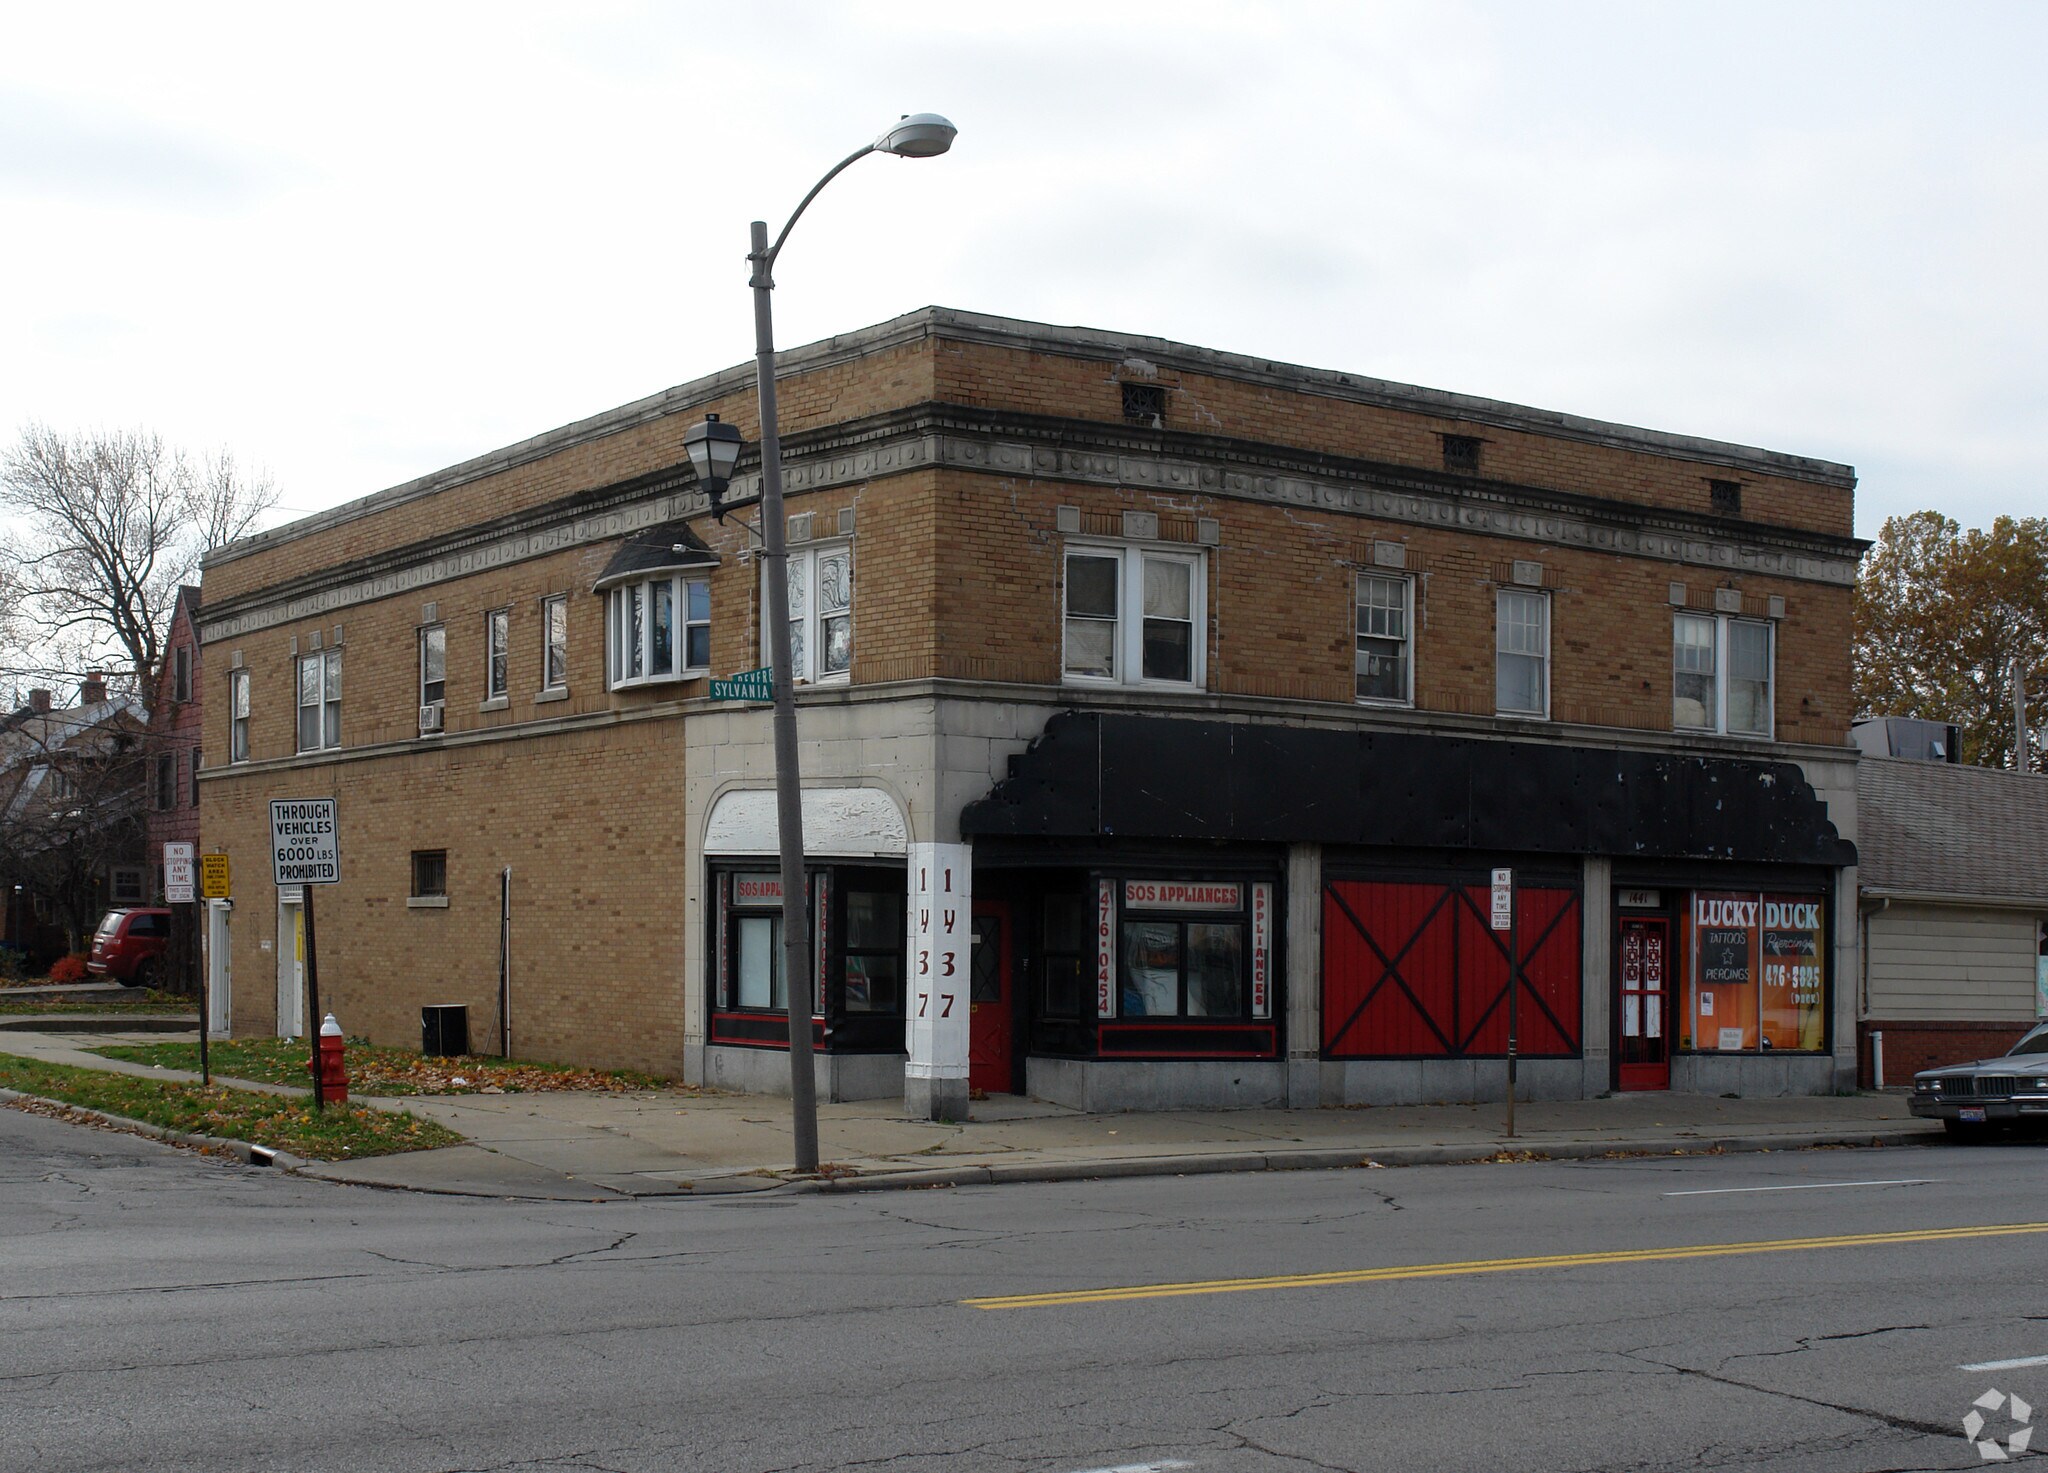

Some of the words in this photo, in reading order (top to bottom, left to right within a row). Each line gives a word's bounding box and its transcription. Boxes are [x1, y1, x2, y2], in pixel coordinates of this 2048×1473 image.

[715, 682, 769, 698] SYLVANIA
[275, 804, 330, 820] THROUGH
[277, 821, 332, 835] VEHICLES
[290, 837, 318, 845] OVER
[174, 847, 184, 855] NO
[278, 847, 315, 861] 6000
[166, 857, 192, 865] STOPPING
[172, 865, 186, 873] ANY
[280, 863, 334, 879] PROHIBITED
[172, 874, 188, 882] TIME
[1498, 873, 1506, 881] NO
[739, 882, 758, 896] SOS
[1126, 885, 1155, 901] SOS
[1159, 886, 1238, 904] APPLIANCES
[1698, 899, 1759, 927] LUCKY
[1765, 903, 1820, 929] DUCK
[1710, 932, 1746, 945] TATTOOS
[1256, 888, 1264, 1006] APPLIANCES
[1705, 967, 1750, 980] PIERCINGS
